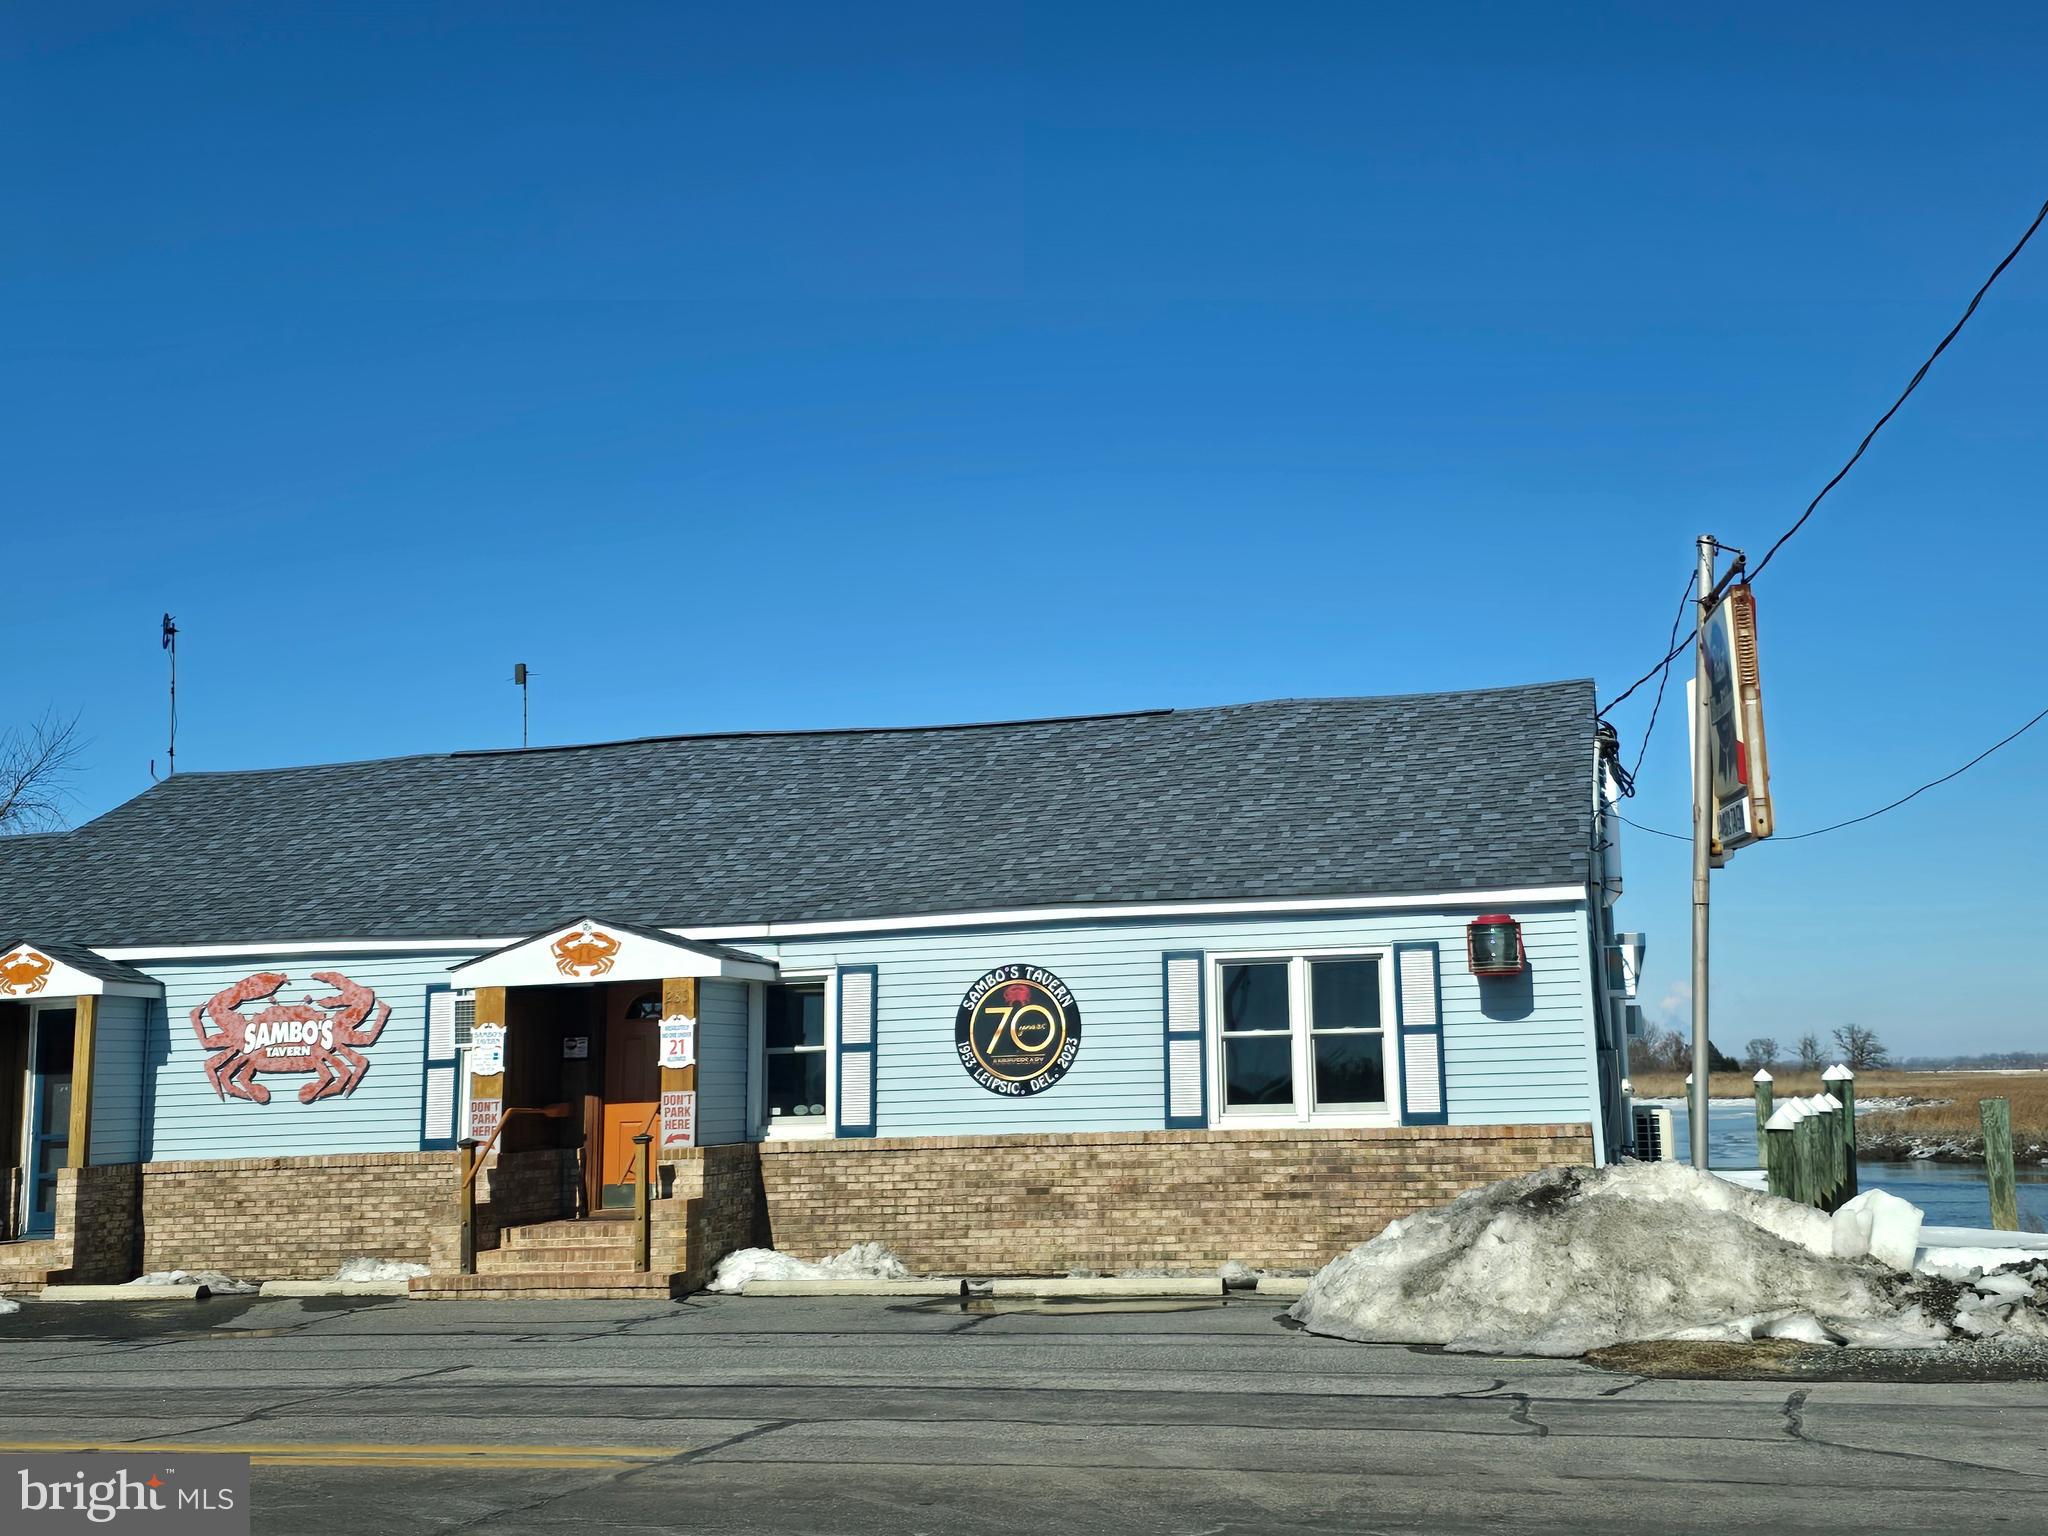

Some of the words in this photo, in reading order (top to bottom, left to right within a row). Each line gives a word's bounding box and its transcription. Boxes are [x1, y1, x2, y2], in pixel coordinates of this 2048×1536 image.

[963, 966, 1019, 1011] SAMBO'S
[1025, 966, 1074, 1008] TAVERN
[984, 1004, 1056, 1055] 70
[243, 1019, 334, 1055] SAMBO'S
[265, 1045, 312, 1058] TAVERN
[669, 1039, 685, 1056] 21
[957, 1040, 977, 1068] 1953
[1056, 1037, 1079, 1069] 2023
[663, 1094, 693, 1106] DON'T
[471, 1101, 500, 1113] DON'T
[664, 1106, 691, 1118] PARK
[471, 1113, 498, 1125] PARK
[664, 1118, 691, 1130] HERE
